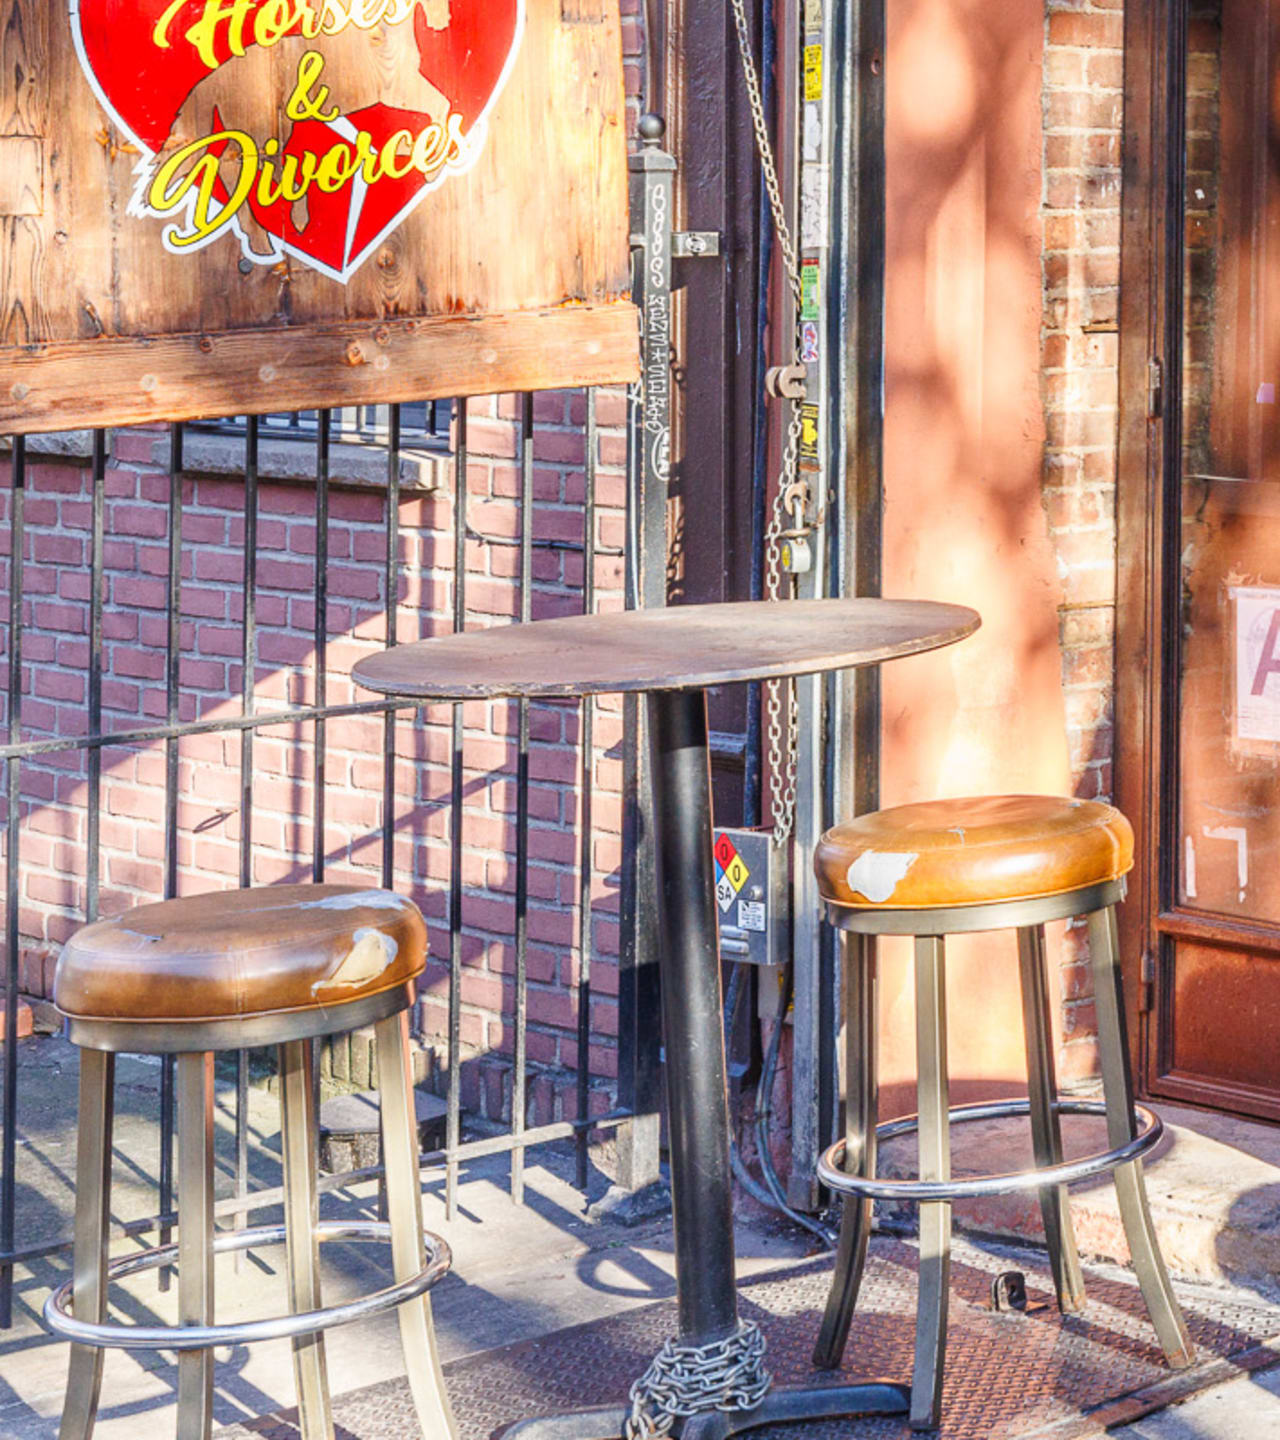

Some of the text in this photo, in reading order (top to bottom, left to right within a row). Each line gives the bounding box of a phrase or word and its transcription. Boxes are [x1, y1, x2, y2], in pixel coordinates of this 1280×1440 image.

[286, 50, 340, 123] &
[148, 113, 477, 248] Divorces
[718, 884, 731, 902] SA
